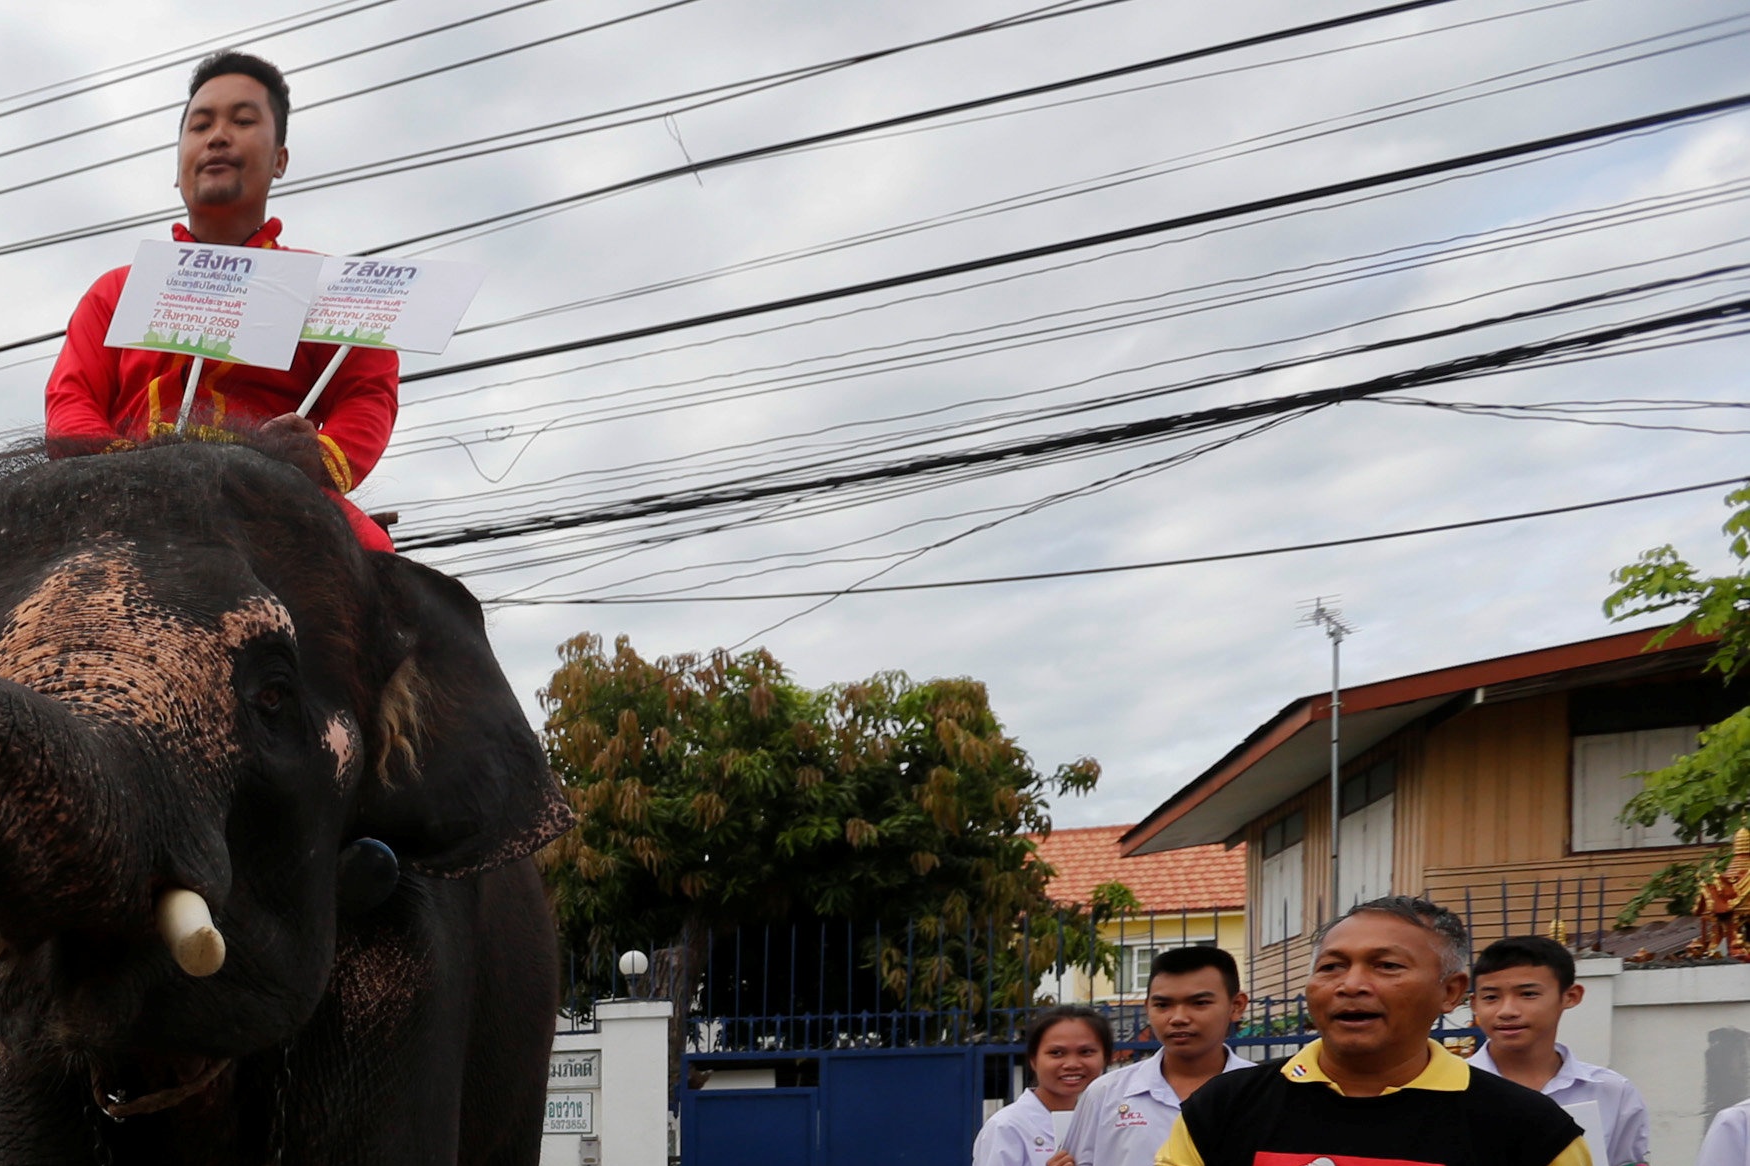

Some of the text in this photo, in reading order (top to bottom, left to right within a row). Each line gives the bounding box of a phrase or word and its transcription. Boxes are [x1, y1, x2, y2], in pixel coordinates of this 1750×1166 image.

[208, 315, 240, 329] 2559
[546, 1095, 583, 1118] องว่าง
